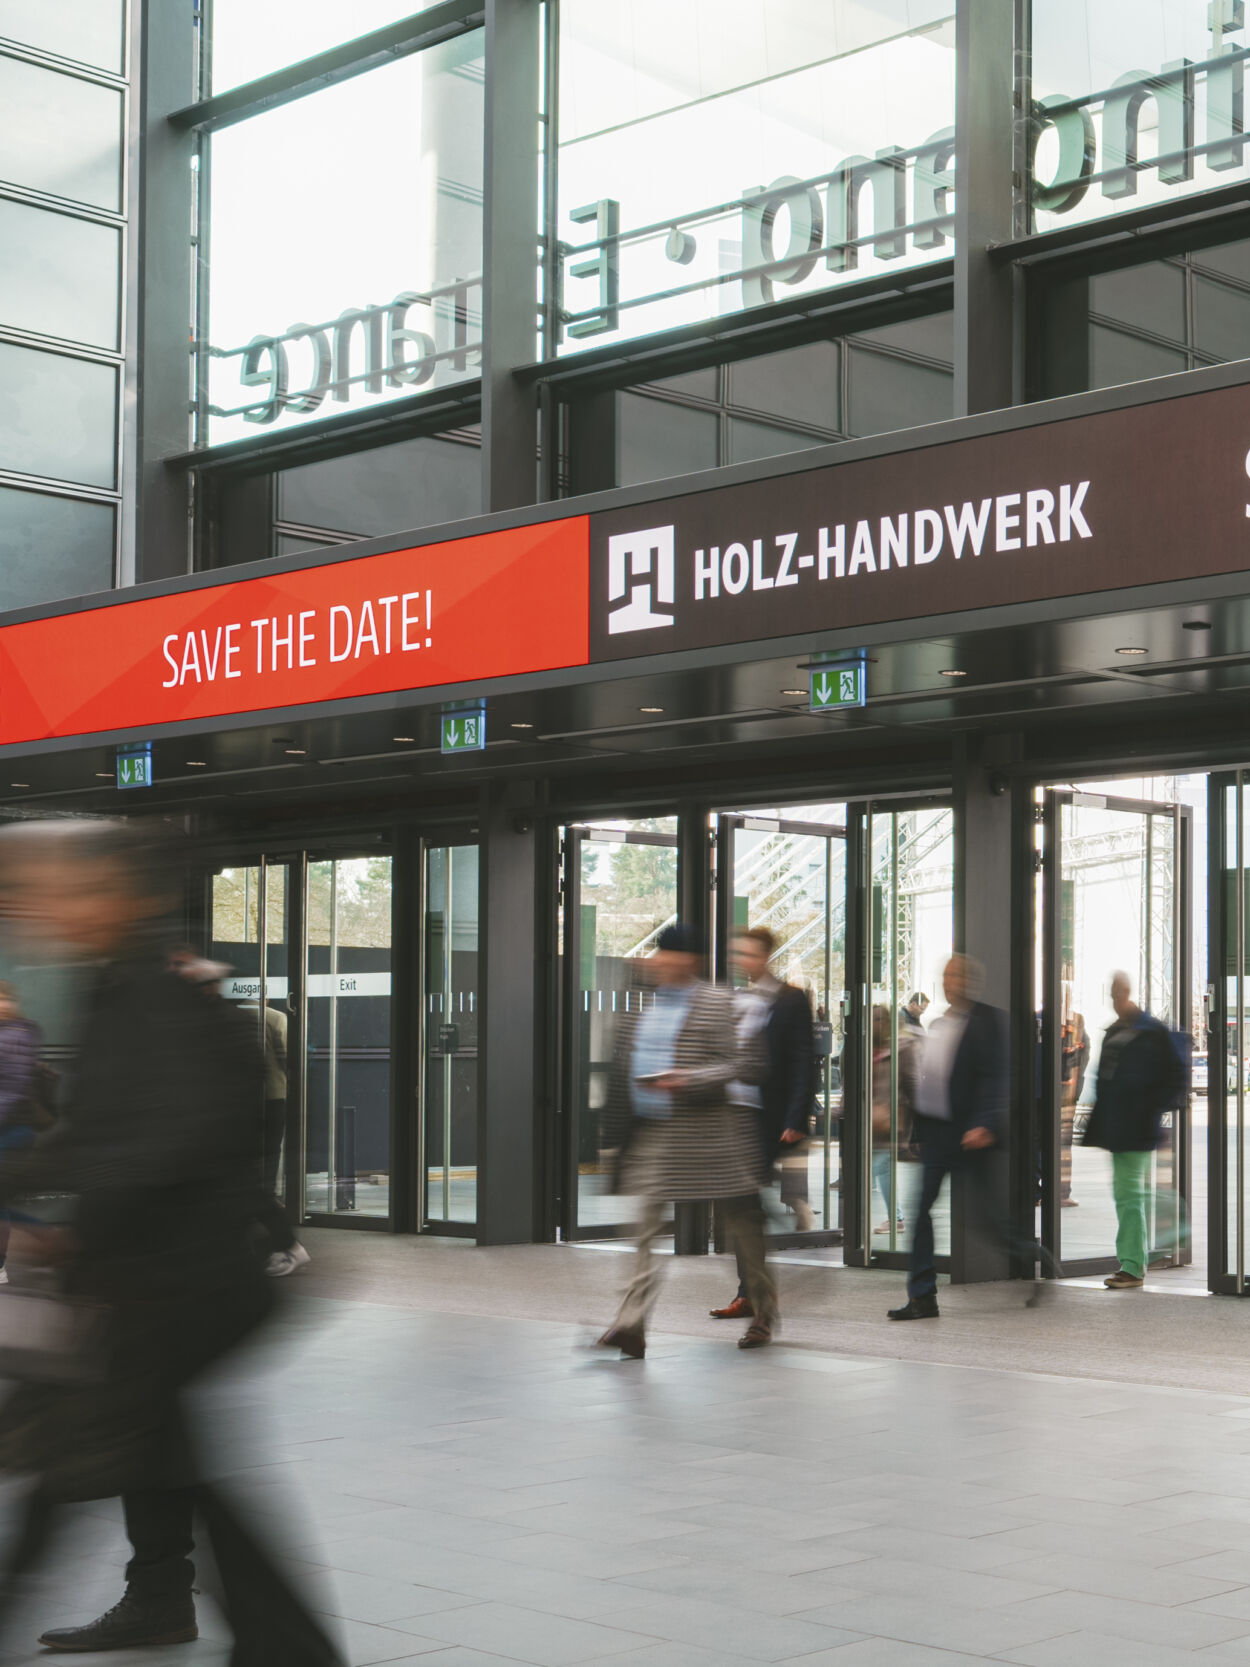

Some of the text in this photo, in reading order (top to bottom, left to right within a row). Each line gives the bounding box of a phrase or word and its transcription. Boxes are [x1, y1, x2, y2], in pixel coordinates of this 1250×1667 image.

[695, 481, 1092, 600] HOLZ-HANDWERK
[162, 589, 432, 688] SAVE THE DATE!
[231, 982, 267, 996] Ausgan
[340, 978, 357, 991] Exit
